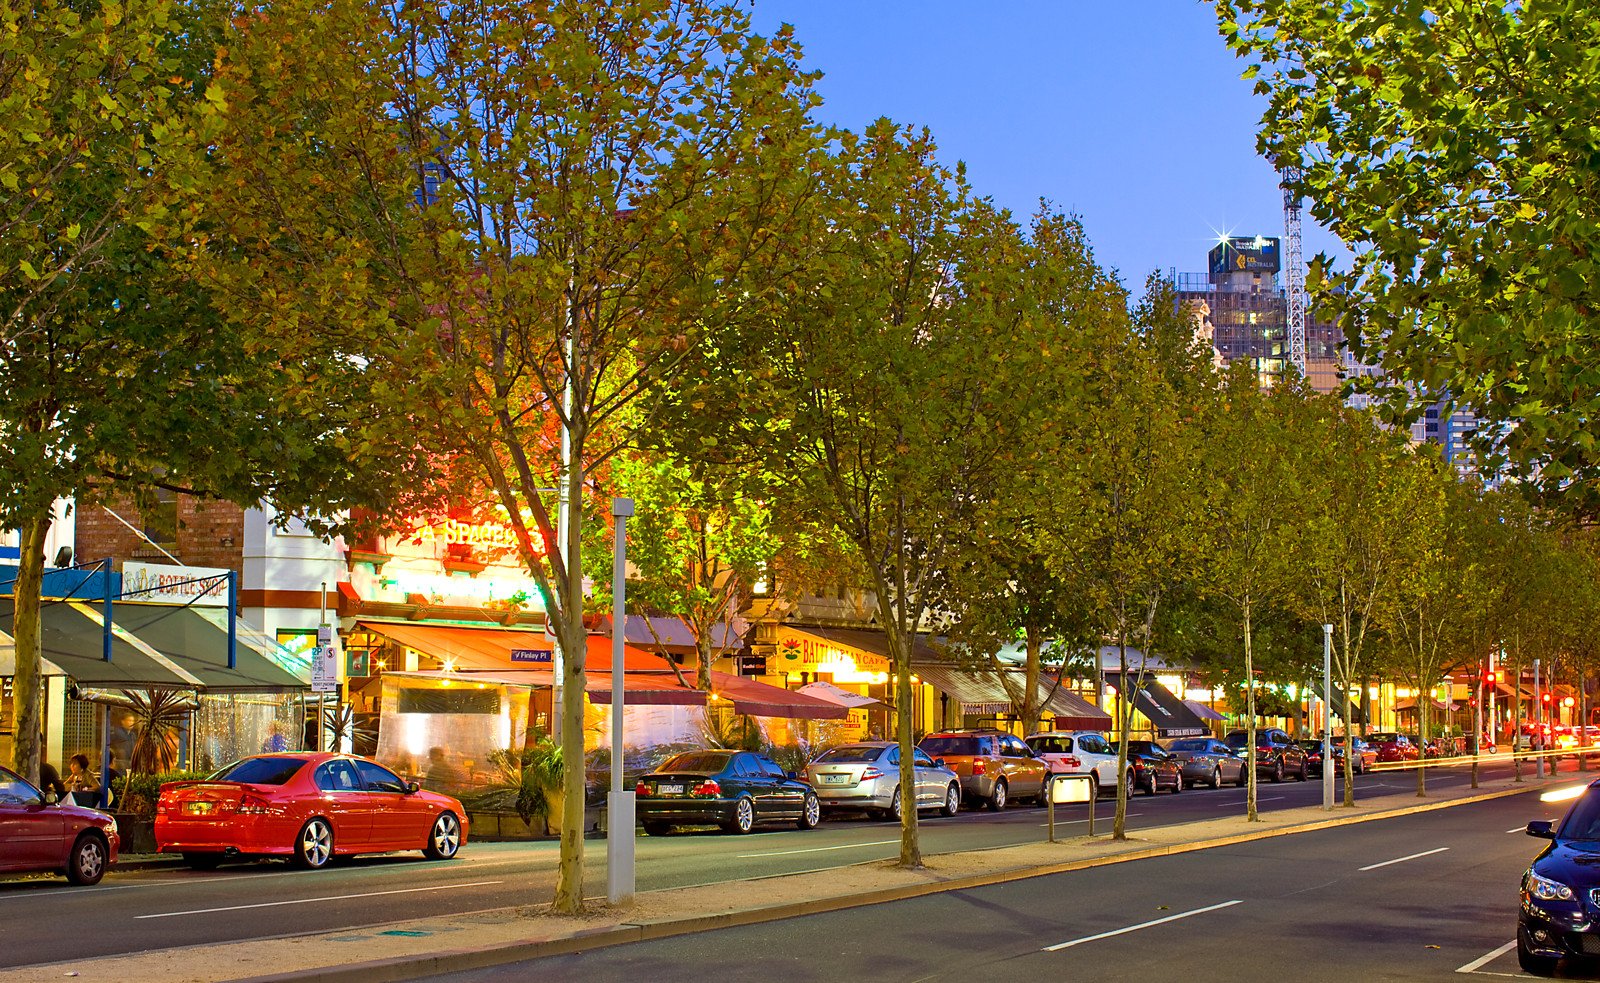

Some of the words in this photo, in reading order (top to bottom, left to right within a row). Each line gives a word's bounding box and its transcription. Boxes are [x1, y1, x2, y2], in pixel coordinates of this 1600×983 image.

[159, 574, 196, 595] BOTTLE
[199, 576, 228, 597] SHOP
[521, 652, 539, 661] Finlay
